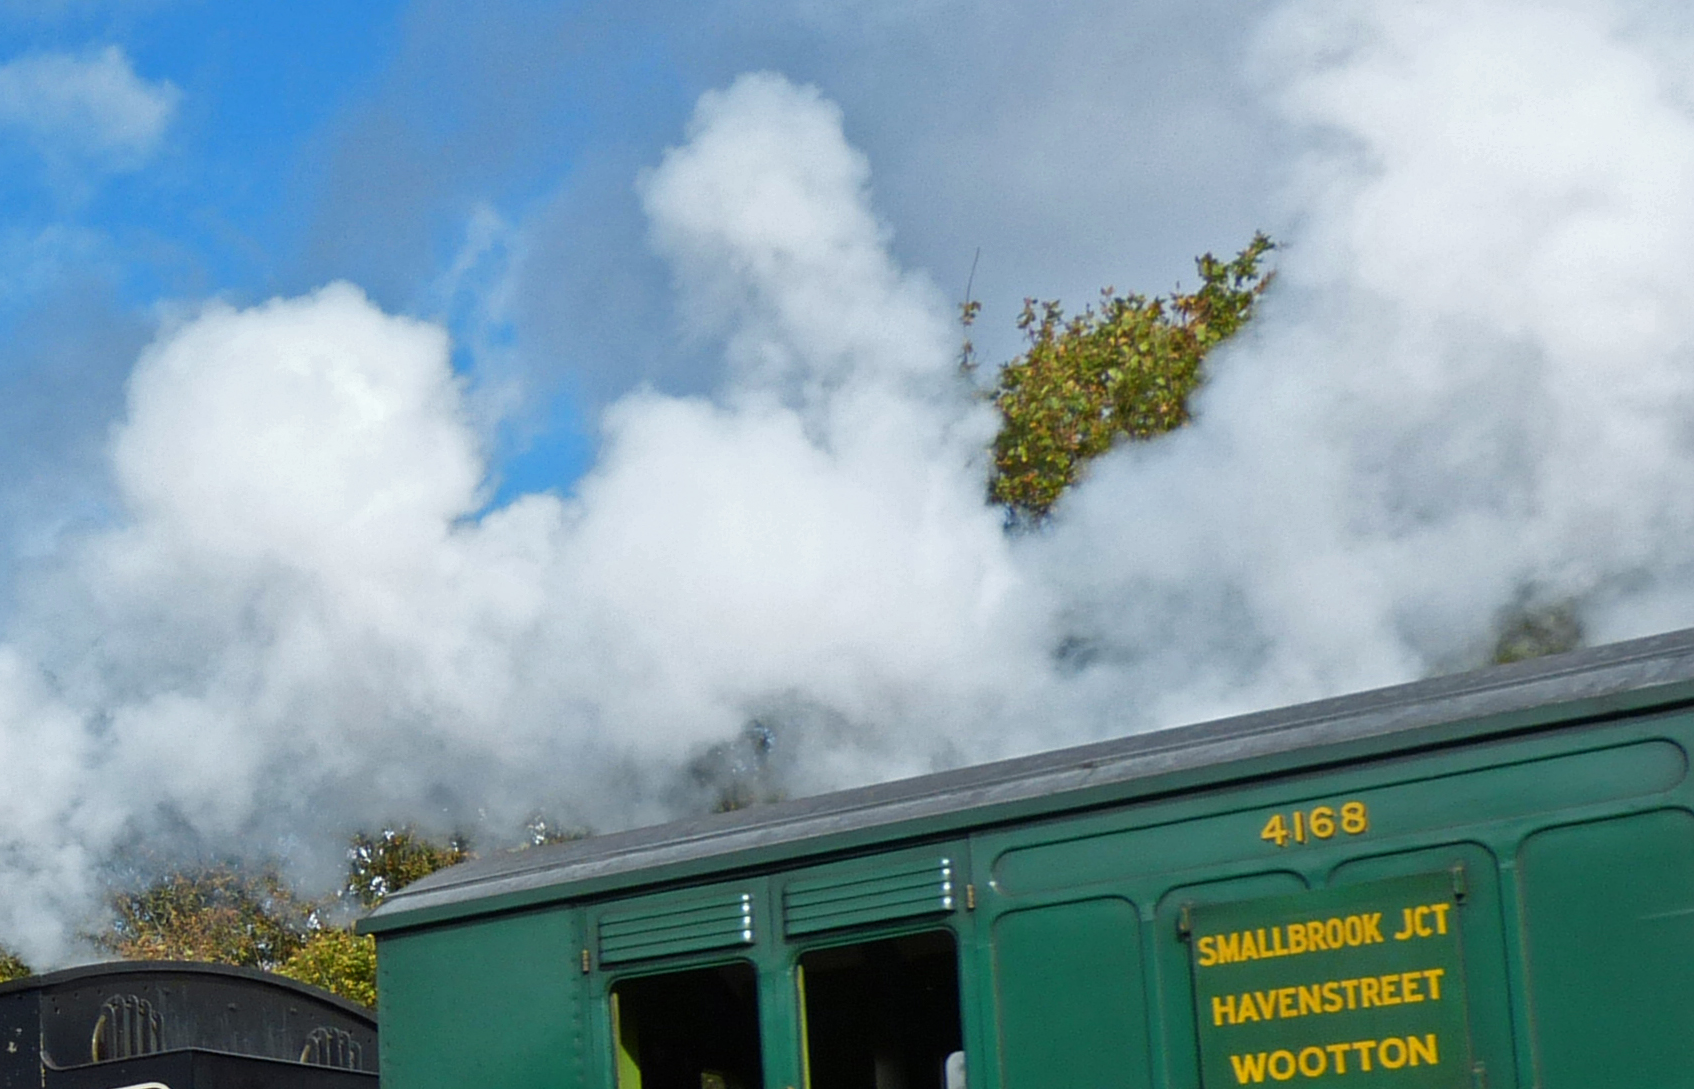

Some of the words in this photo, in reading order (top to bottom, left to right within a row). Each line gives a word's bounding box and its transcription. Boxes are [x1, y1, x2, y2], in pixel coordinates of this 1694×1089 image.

[1260, 800, 1369, 846] 4168
[1198, 912, 1384, 967] SMALLBROOK
[1394, 903, 1450, 940] JCT
[1211, 968, 1445, 1026] HAVENSTREET
[1230, 1033, 1439, 1085] WOOTTON
